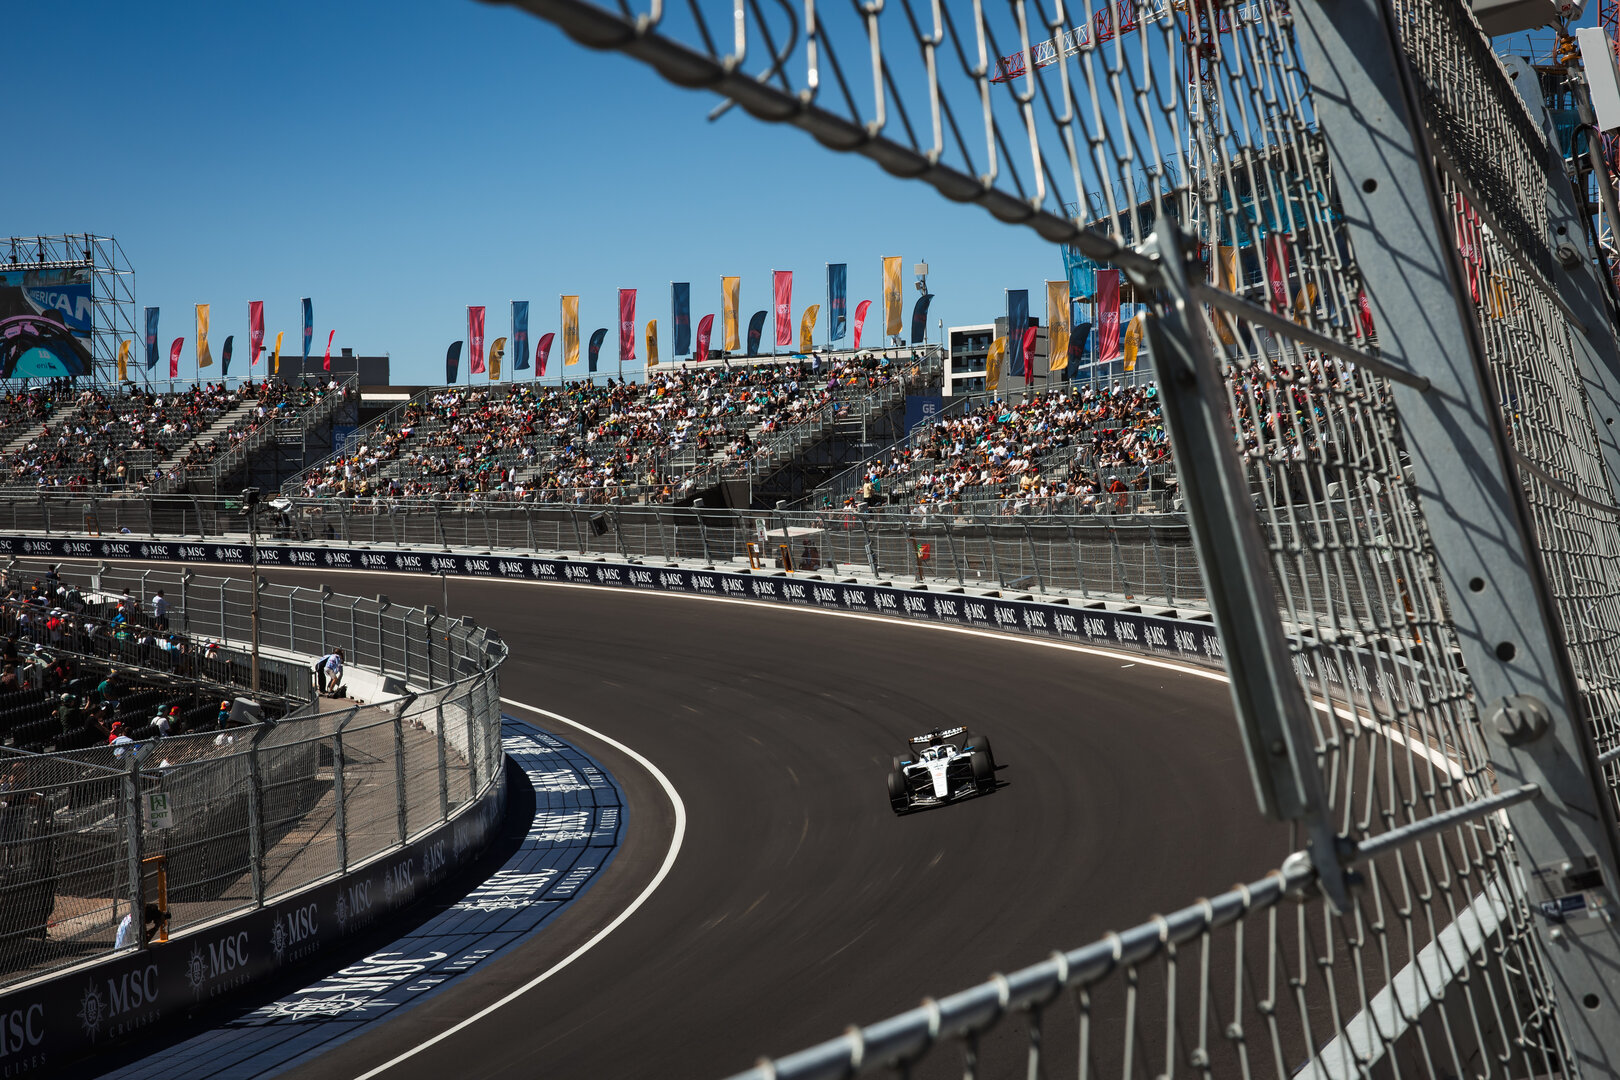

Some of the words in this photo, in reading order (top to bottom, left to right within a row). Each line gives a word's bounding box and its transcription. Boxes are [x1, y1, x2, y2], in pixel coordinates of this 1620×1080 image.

[922, 404, 936, 414] GE
[0, 540, 12, 550] SC
[32, 542, 52, 551] MSC
[72, 542, 92, 552] MSC
[110, 544, 130, 553] MSC
[150, 546, 168, 555] MSC
[186, 547, 206, 556] MSC
[224, 548, 242, 558] MSC
[260, 550, 279, 560] MSC
[298, 552, 316, 562] MSC
[333, 553, 351, 563] MSC
[368, 554, 386, 565] MSC
[404, 556, 422, 566] MSC
[439, 558, 456, 569] MSC
[472, 560, 490, 571] MSC
[506, 562, 524, 572] MSC
[539, 564, 556, 575] MSC
[572, 566, 589, 578] MSC
[604, 568, 620, 580] MSC
[636, 570, 652, 582] MSC
[666, 573, 684, 585] MSC
[698, 576, 715, 588] MSC
[728, 578, 744, 591] MSC
[759, 581, 776, 594] MSC
[789, 584, 805, 598] MSC
[820, 588, 836, 601] MSC
[850, 590, 866, 604] MSC
[880, 594, 897, 608] MSC
[909, 596, 926, 611] MSC
[940, 600, 958, 615] MSC
[970, 604, 987, 619] MSC
[1000, 607, 1017, 624] MSC
[1030, 610, 1047, 627] MSC
[1060, 614, 1077, 632] MSC
[1090, 618, 1107, 636] MSC
[1120, 622, 1137, 640] MSC
[1150, 626, 1168, 646] MSC
[1180, 630, 1197, 652] MSC
[394, 858, 415, 894] MSC
[466, 868, 558, 897] MSC
[349, 880, 373, 917] MSC
[287, 903, 319, 946] MSC
[209, 931, 249, 979] MSC
[294, 951, 448, 994] MSC
[107, 964, 159, 1018] MSC
[109, 1009, 160, 1038] CRUISES
